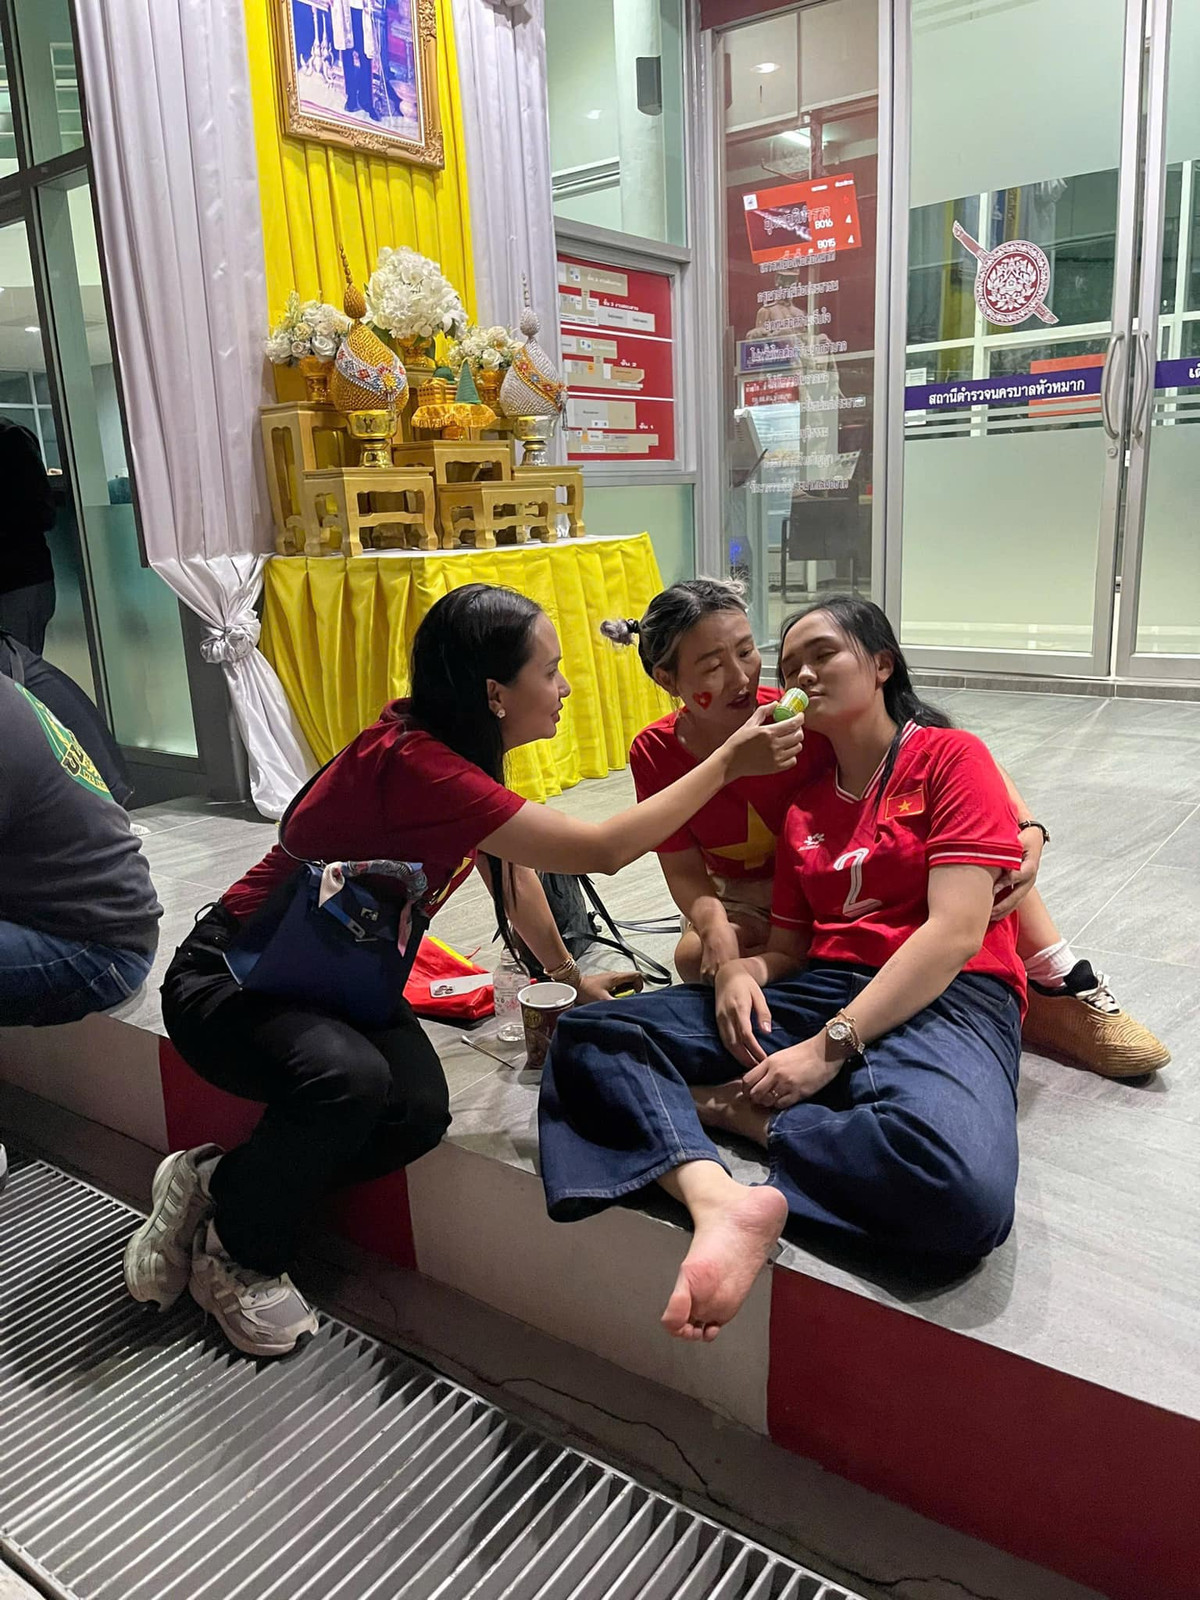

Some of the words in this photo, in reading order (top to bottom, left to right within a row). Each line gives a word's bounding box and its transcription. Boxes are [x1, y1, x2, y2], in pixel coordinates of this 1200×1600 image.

[814, 218, 833, 229] B016
[817, 238, 836, 249] B015
[928, 379, 1085, 404] สถานีตำรวจนครบาลหัวหมาก
[833, 847, 883, 918] 2
